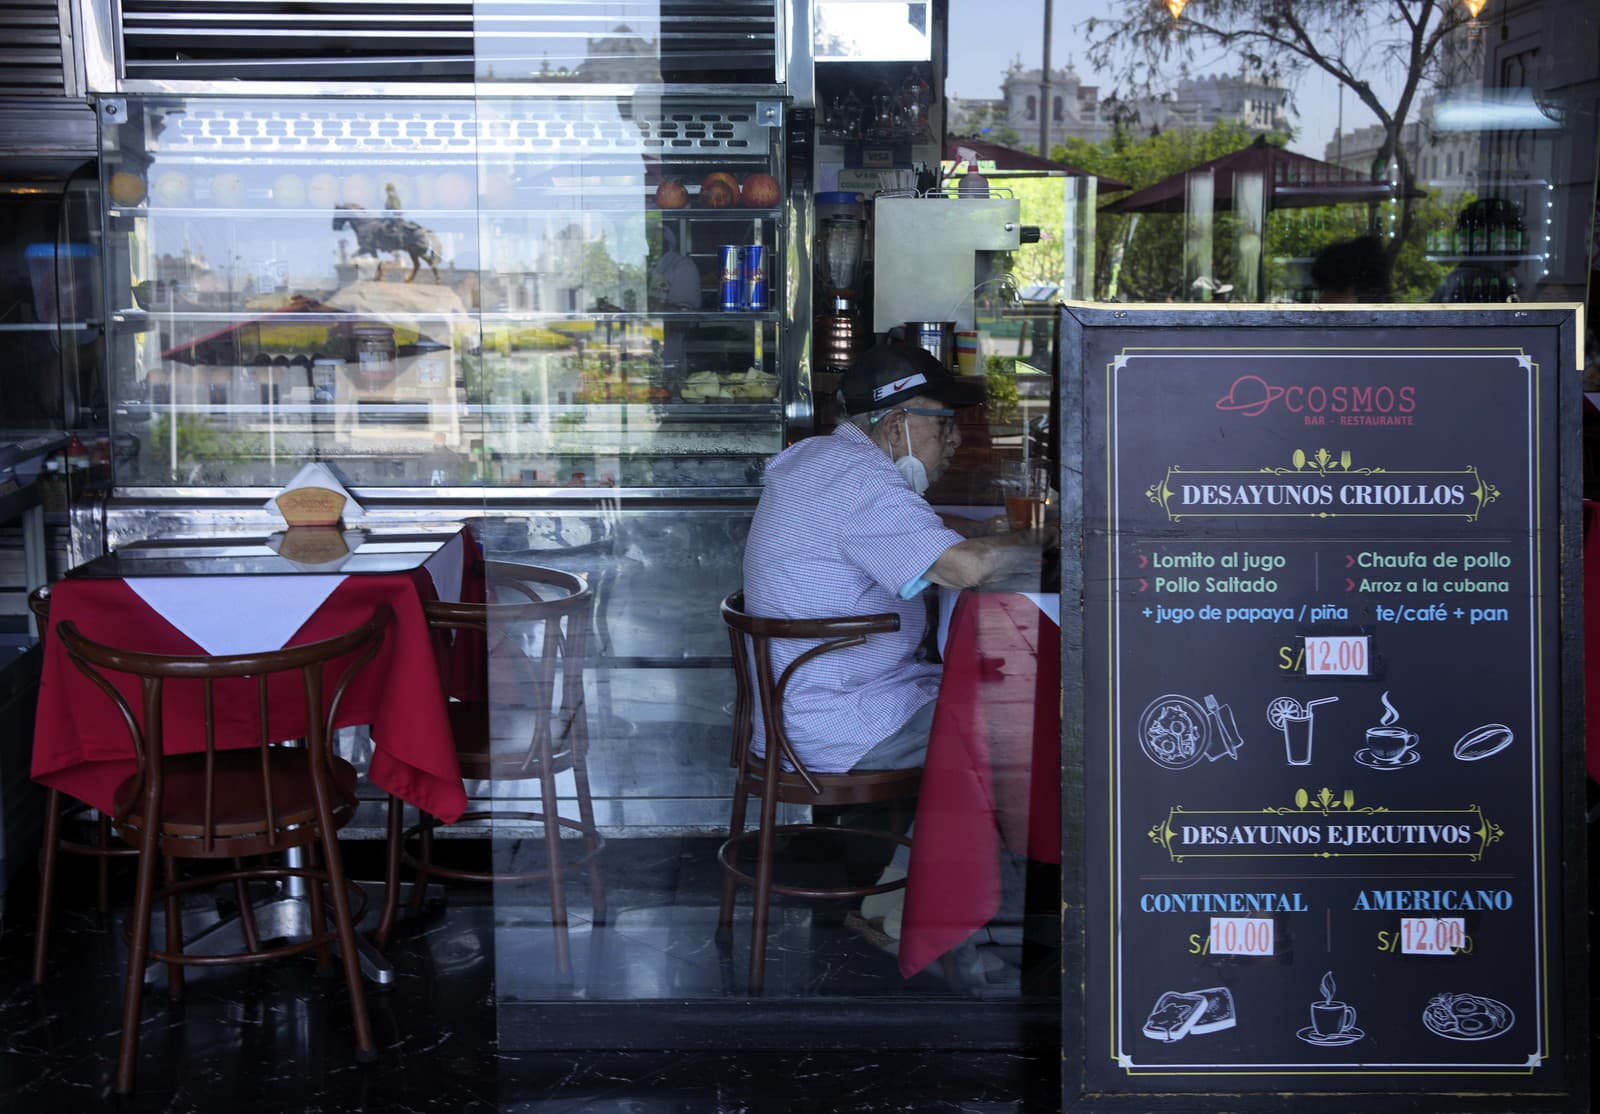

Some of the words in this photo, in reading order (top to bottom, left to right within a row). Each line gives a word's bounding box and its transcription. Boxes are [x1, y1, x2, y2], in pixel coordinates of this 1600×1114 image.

[1285, 387, 1417, 413] COSMOS
[1304, 416, 1326, 425] BAR
[1340, 416, 1414, 425] RESTAURANTE
[1181, 485, 1333, 505] DESAYUNOS
[1340, 485, 1465, 505] CRIOLLOS
[1153, 552, 1215, 568] Lomito
[1221, 552, 1239, 568] al
[1242, 552, 1286, 572] jugo
[1357, 552, 1427, 568] Chaufa
[1433, 552, 1459, 568] de
[1464, 552, 1512, 572] pollo
[1155, 577, 1200, 593] Pollo
[1206, 577, 1278, 593] Saltado
[1358, 579, 1403, 593] Arroz
[1406, 581, 1418, 593] a
[1422, 578, 1438, 593] la
[1442, 578, 1509, 593] cubana
[1155, 605, 1195, 624] jugo
[1199, 605, 1223, 620] de
[1225, 607, 1295, 624] papaya
[1310, 604, 1349, 624] piña
[1375, 603, 1448, 624] te/café
[1471, 608, 1509, 625] pan
[1182, 826, 1321, 845] DESAYUNOS
[1328, 825, 1471, 846] EJECUTIVOS
[1140, 893, 1308, 912] CONTINENTAL
[1353, 890, 1513, 911] AMERICANO
